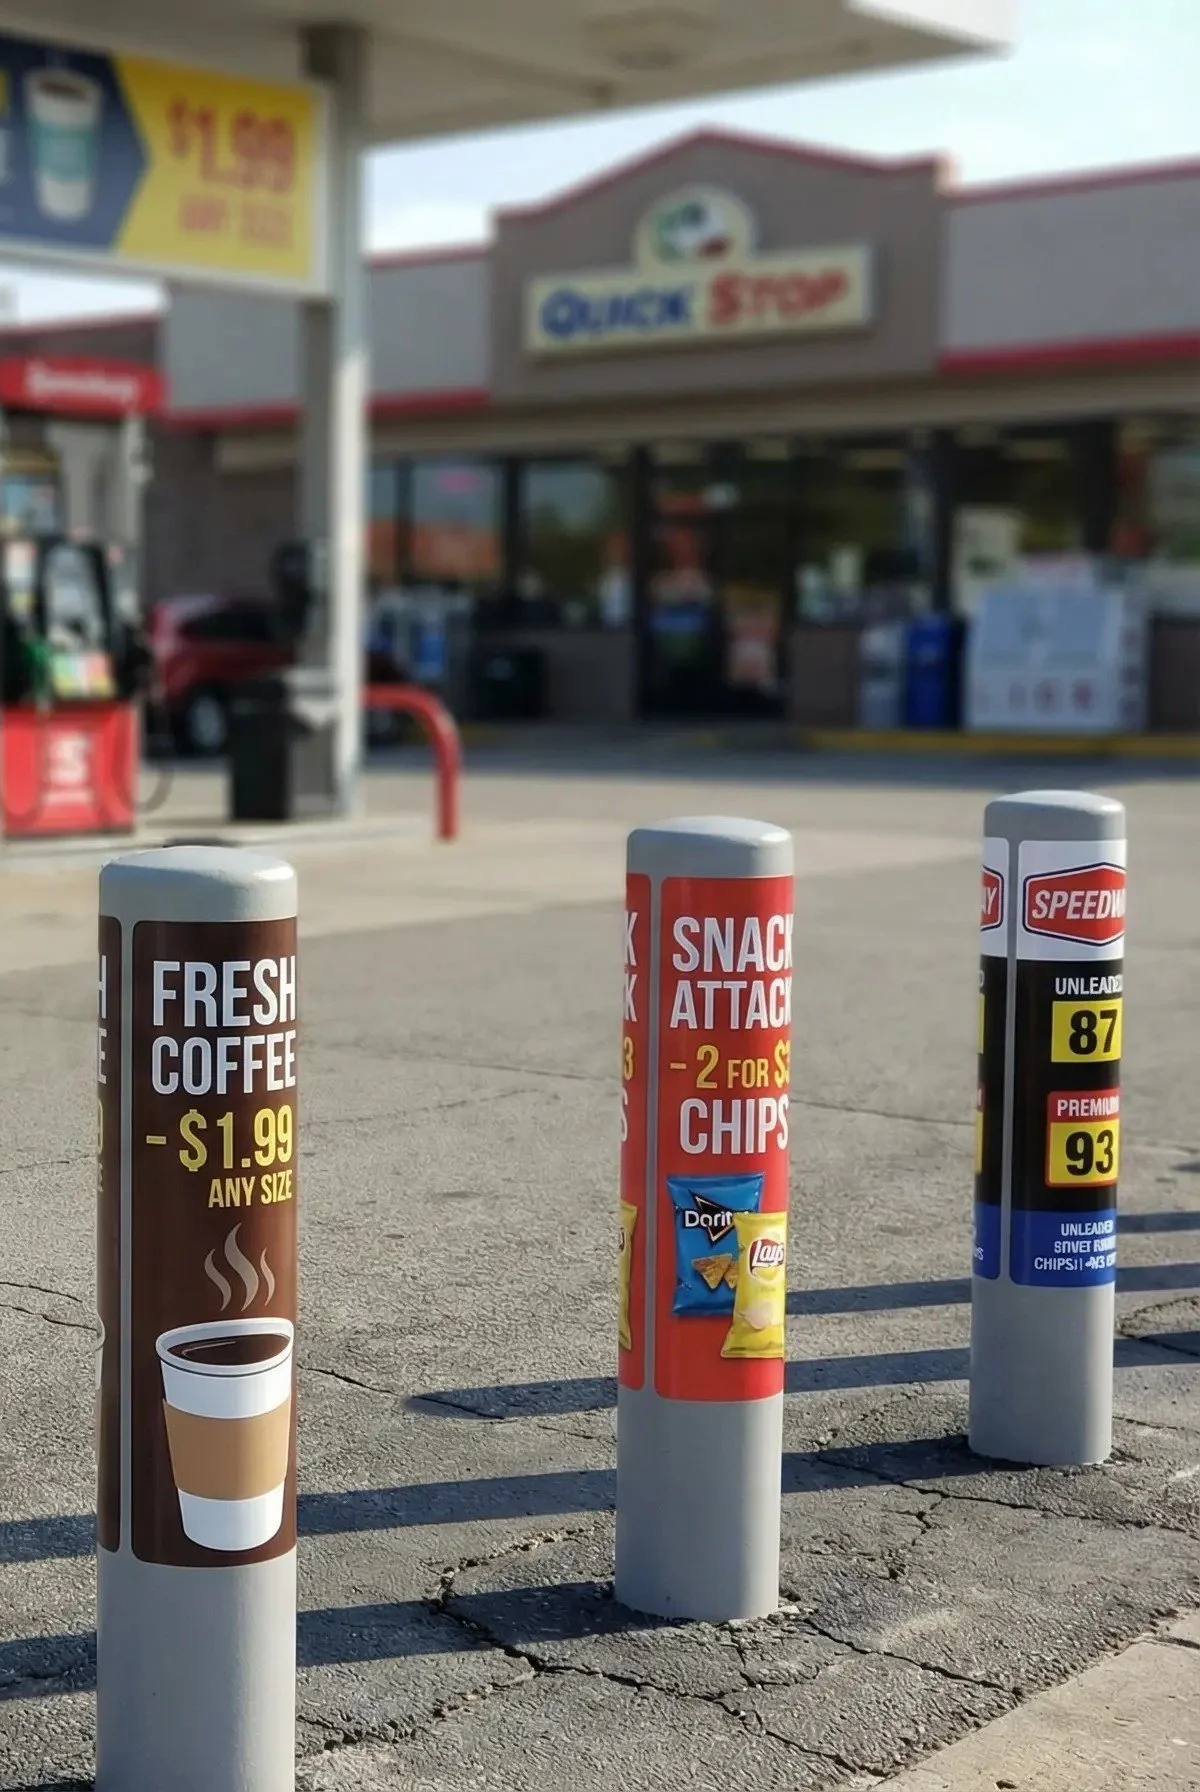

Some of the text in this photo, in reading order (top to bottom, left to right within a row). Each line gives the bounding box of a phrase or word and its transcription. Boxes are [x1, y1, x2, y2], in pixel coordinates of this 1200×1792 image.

[167, 97, 294, 195] $1.99
[539, 268, 848, 338] QUICK STOP
[1031, 889, 1126, 920] SPEEDW
[152, 955, 296, 1027] FRESH
[1069, 1009, 1118, 1055] 87
[152, 1029, 296, 1095] COFFEE
[696, 1045, 720, 1089] 2
[727, 1058, 770, 1089] FOR
[680, 1096, 789, 1155] CHIPS
[1065, 1130, 1114, 1176] 93
[208, 1169, 293, 1208] ANY SIZE
[684, 1210, 733, 1227] Dorit
